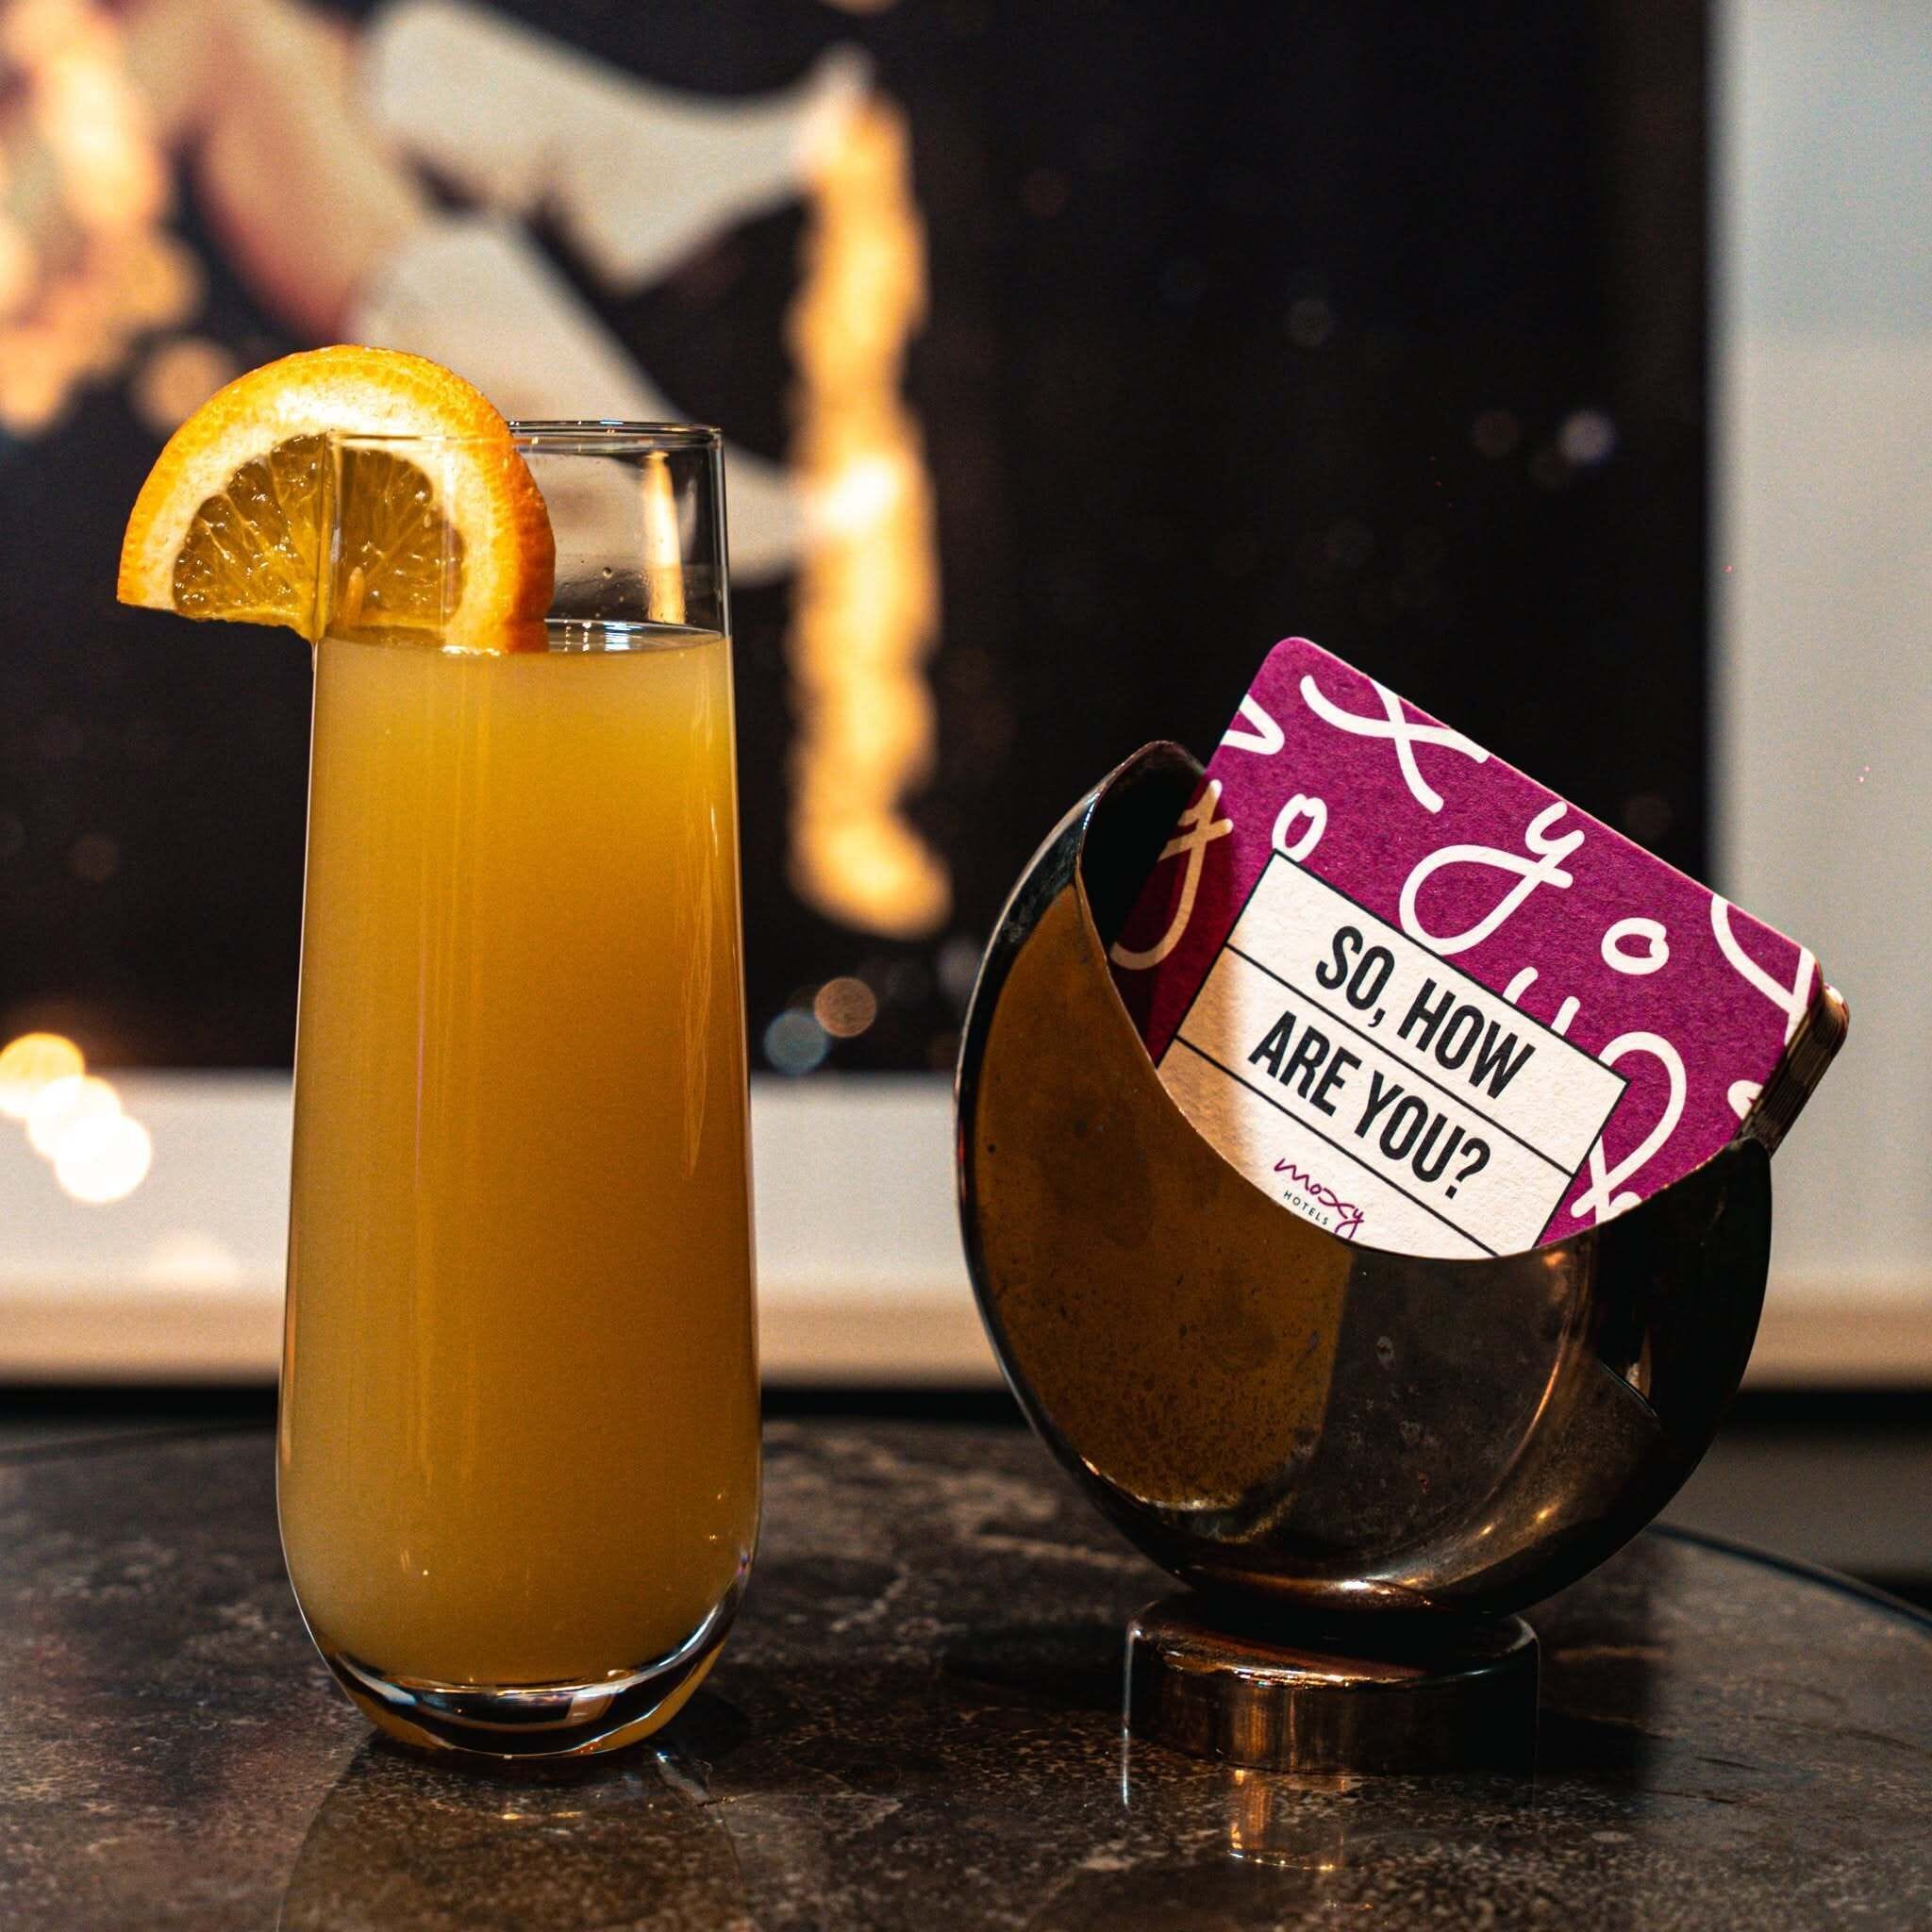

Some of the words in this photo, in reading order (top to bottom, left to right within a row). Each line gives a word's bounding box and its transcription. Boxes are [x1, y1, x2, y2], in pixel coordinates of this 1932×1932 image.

[1315, 925, 1395, 1027] SO,
[1397, 977, 1537, 1099] HOW
[1247, 1010, 1362, 1117] ARE
[1354, 1070, 1491, 1199] YOU?
[1274, 1158, 1364, 1240] moxy
[1283, 1191, 1329, 1225] HOTELS
